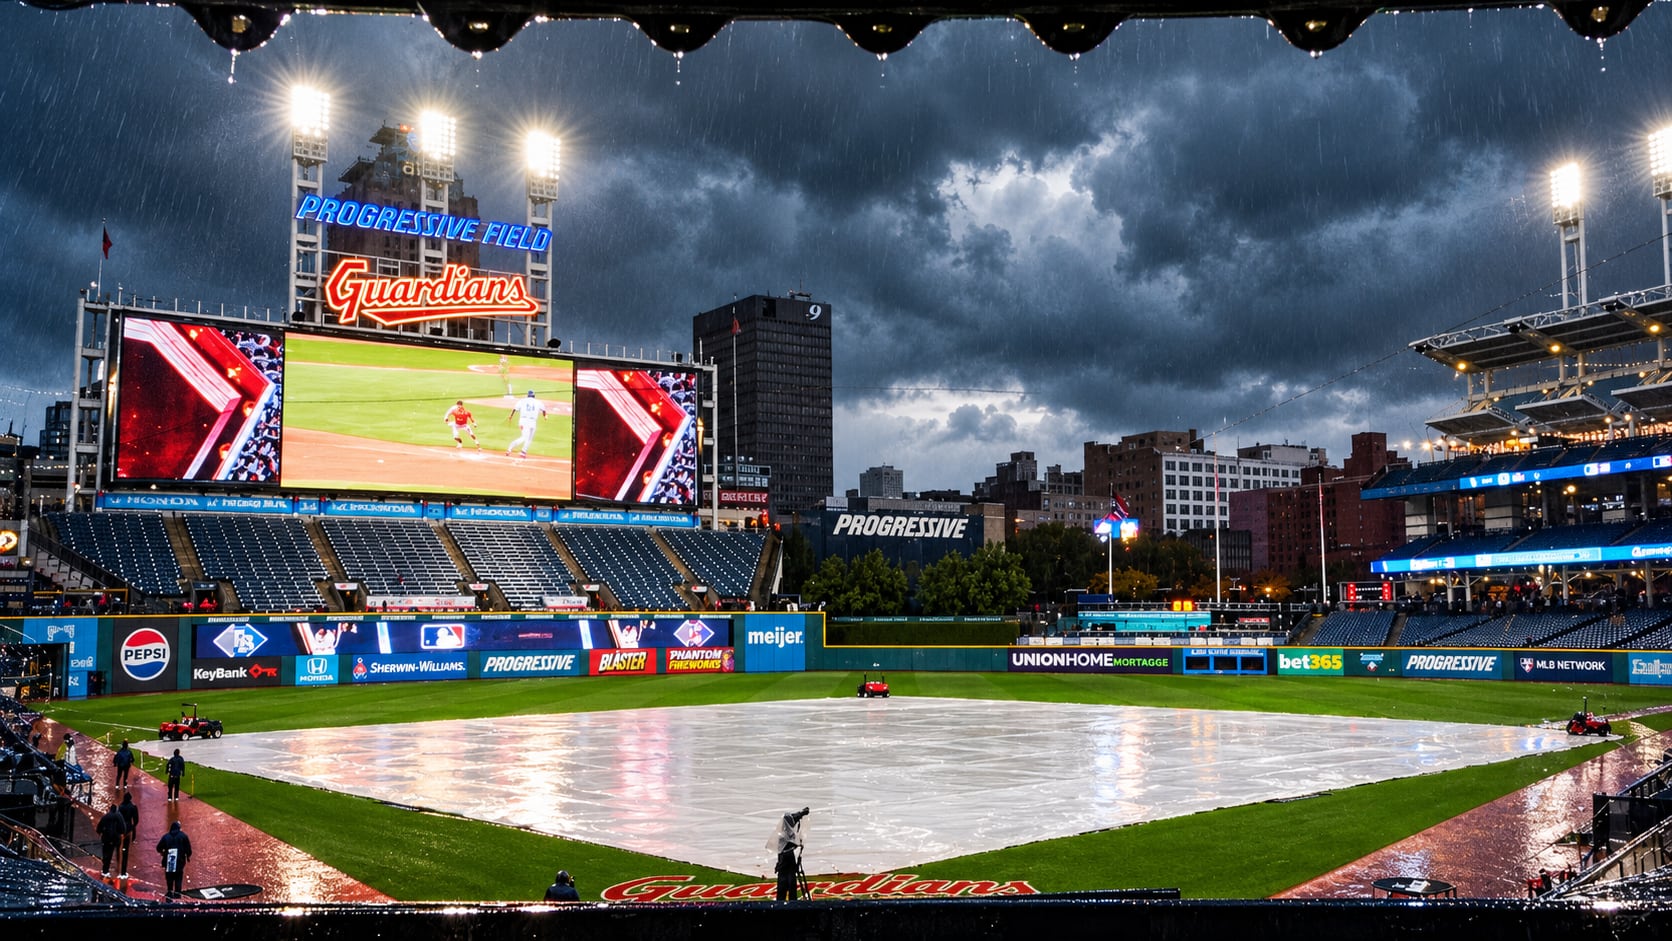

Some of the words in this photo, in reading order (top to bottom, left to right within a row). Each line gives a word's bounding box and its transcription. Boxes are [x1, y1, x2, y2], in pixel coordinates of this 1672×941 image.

[296, 194, 480, 242] PROGRESSIVE
[481, 220, 553, 252] FIELD
[325, 258, 540, 326] Guardians
[809, 304, 822, 321] 9
[833, 514, 969, 539] PROGRESSIVE
[124, 648, 166, 661] PEPSI
[670, 649, 722, 660] PHANTOM
[1279, 654, 1342, 670] bet365
[483, 654, 575, 672] PROGRESSIVE
[1406, 655, 1497, 671] PROGRESSIVE
[1536, 660, 1555, 670] MLB
[1557, 660, 1606, 671] NETWORK
[193, 666, 248, 681] KeyBank
[601, 874, 1041, 902] Guardians
